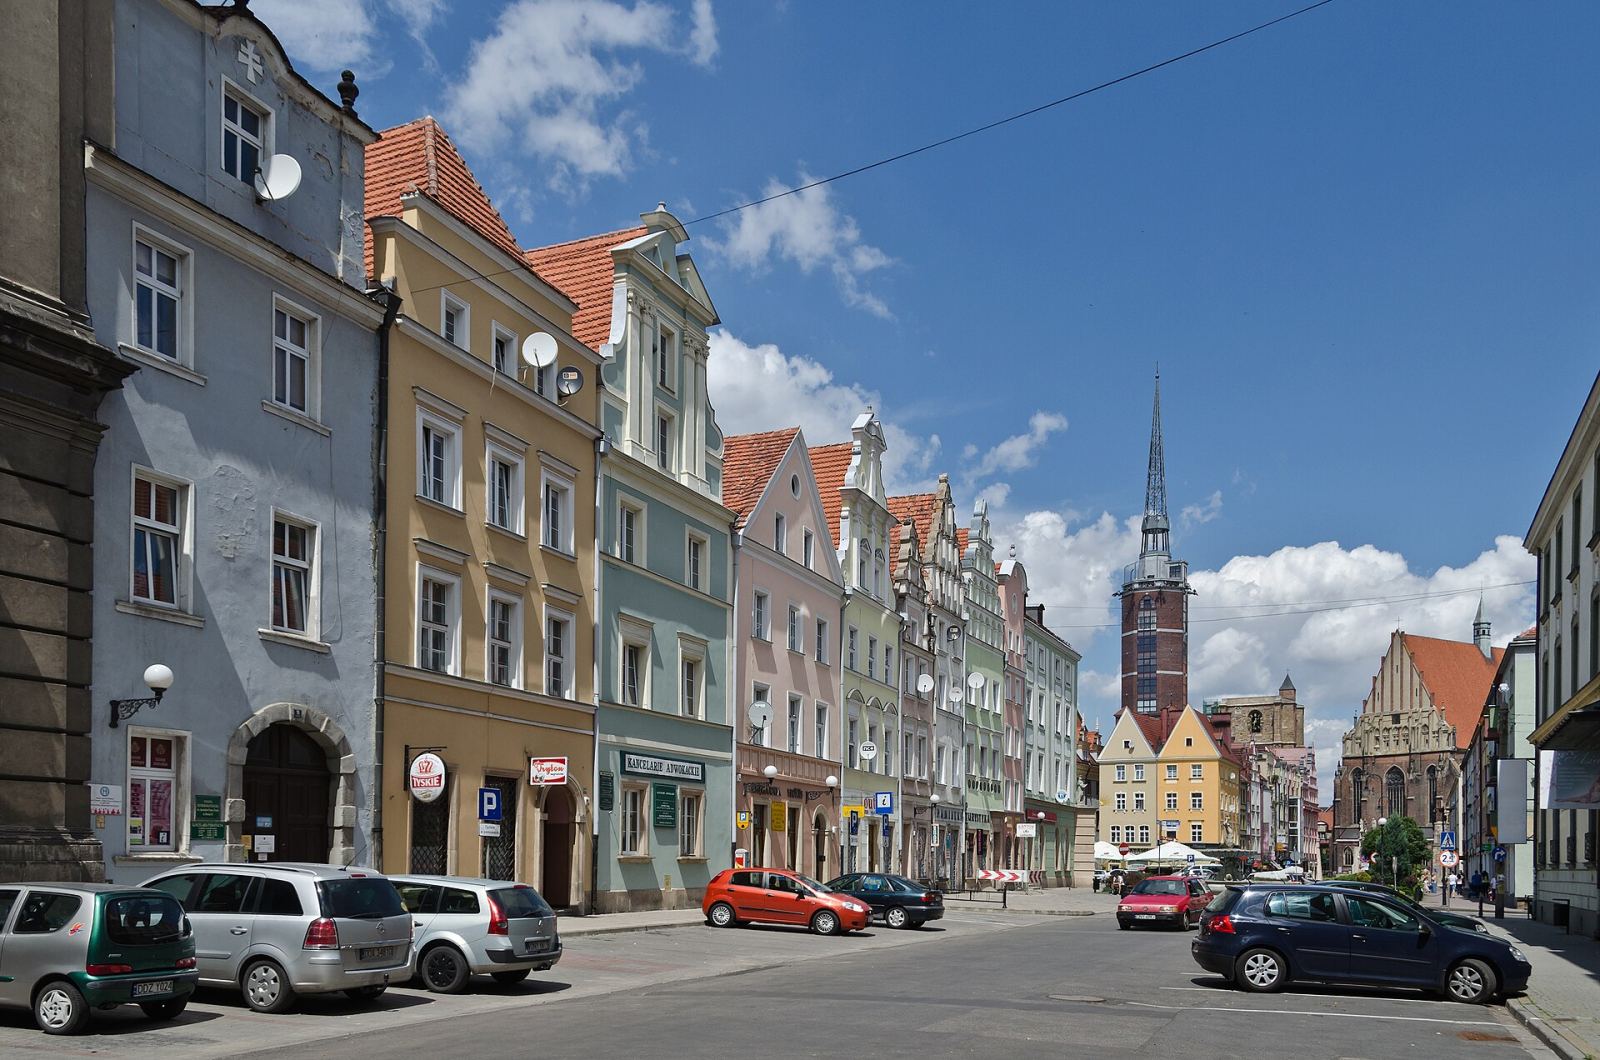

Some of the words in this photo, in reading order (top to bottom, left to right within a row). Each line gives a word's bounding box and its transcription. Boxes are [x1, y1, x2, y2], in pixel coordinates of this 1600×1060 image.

[627, 757, 663, 772] KANCELARIE
[666, 763, 700, 776] ADWOKACKIE
[412, 776, 440, 787] TYSKIE
[483, 792, 497, 816] P
